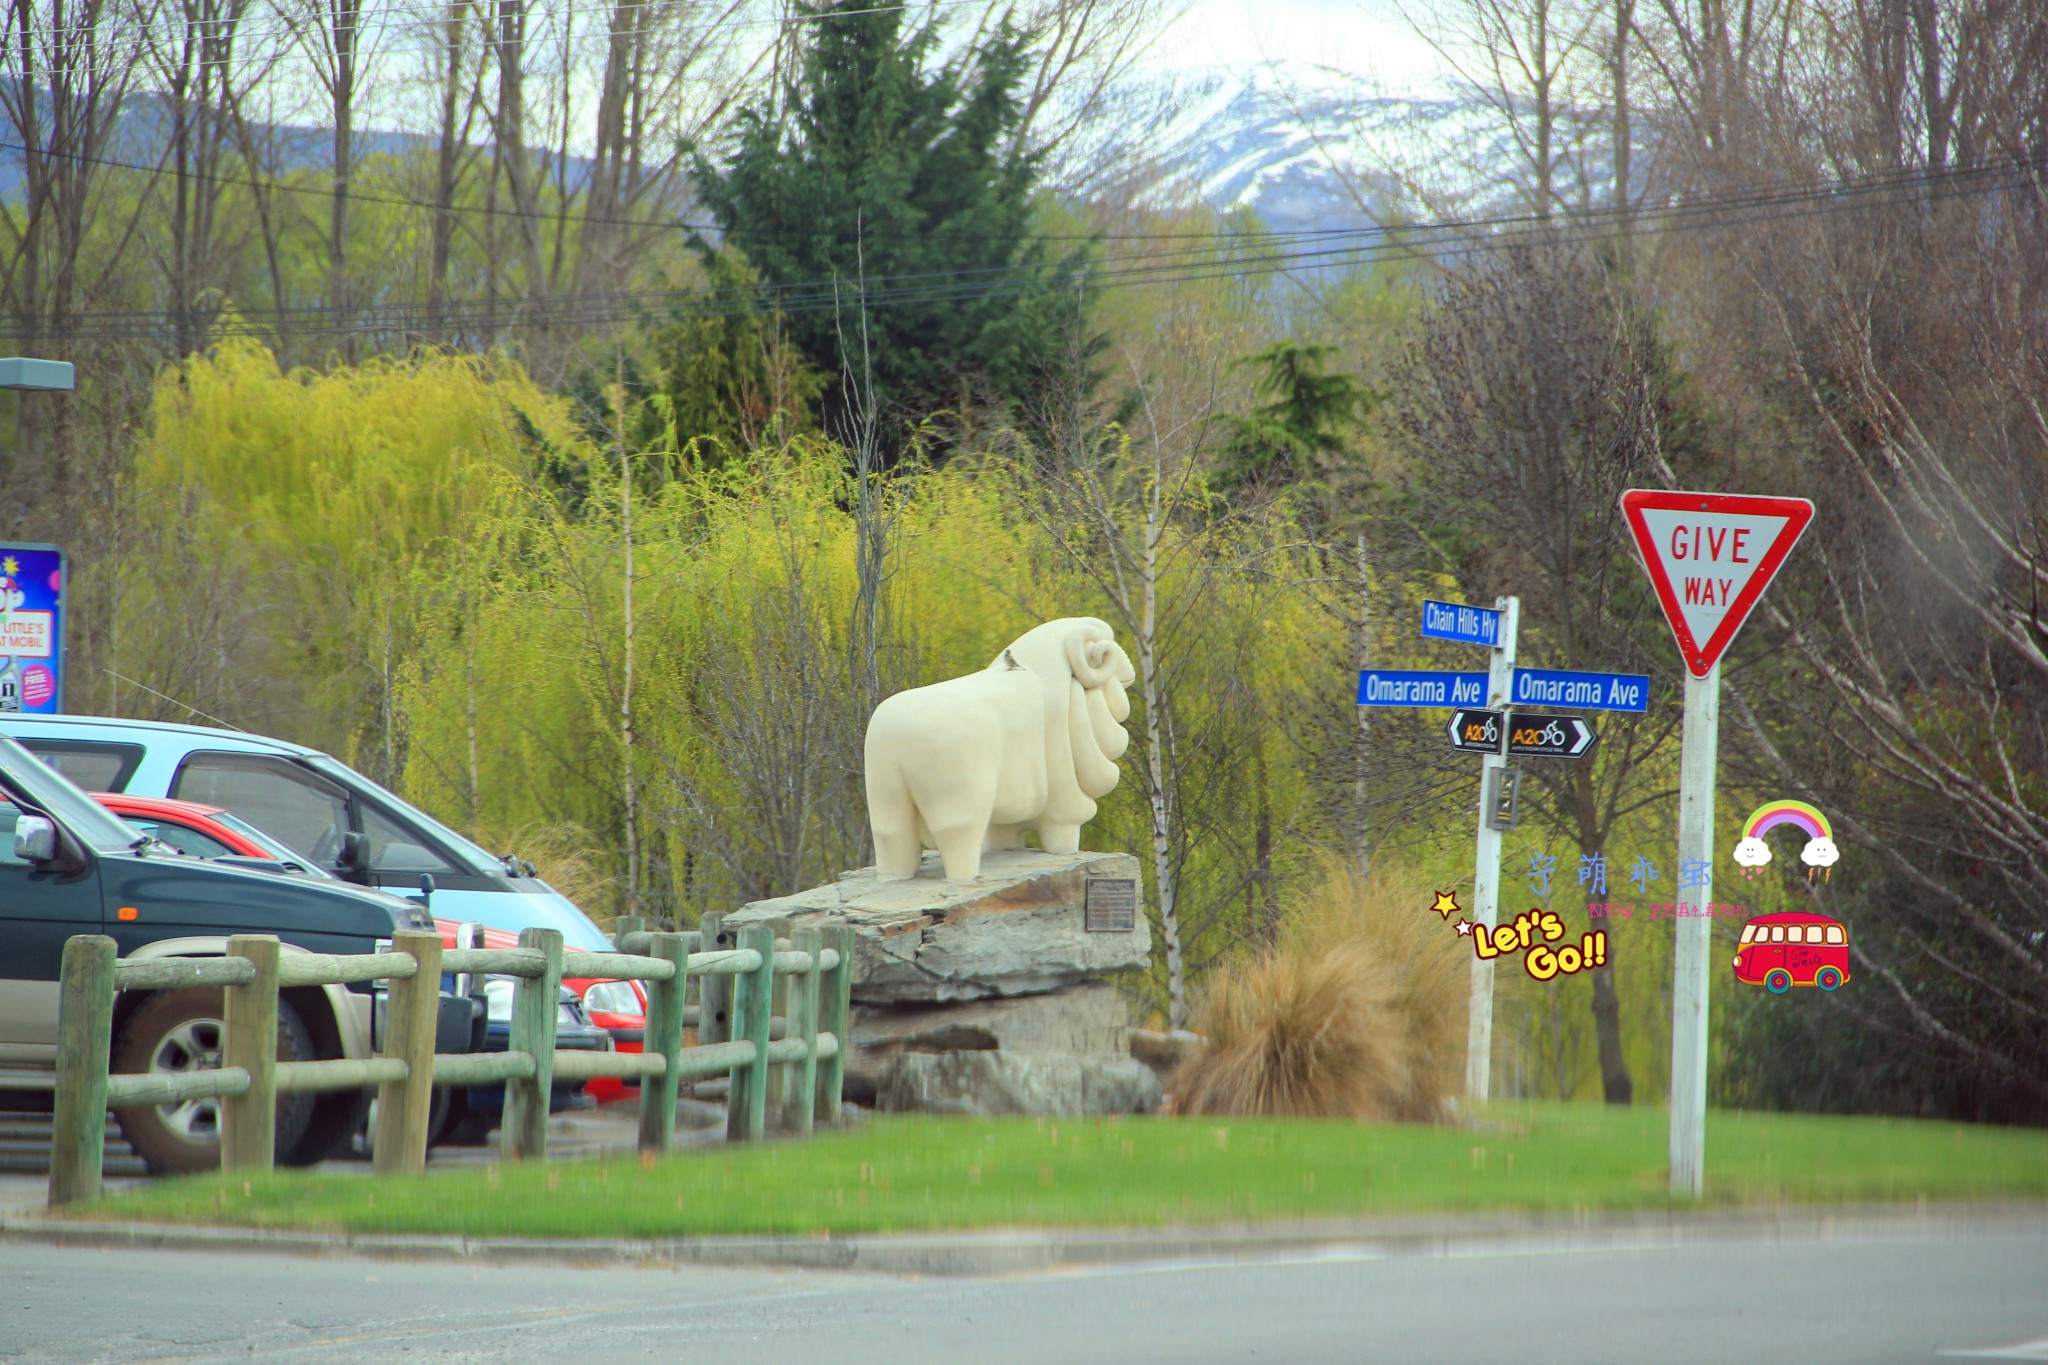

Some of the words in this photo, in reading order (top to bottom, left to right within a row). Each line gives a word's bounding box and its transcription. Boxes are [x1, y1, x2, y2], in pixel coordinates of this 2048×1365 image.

[1671, 525, 1750, 563] GIVE
[1685, 577, 1733, 607] WAY
[3, 622, 45, 635] LITTLE'S
[1426, 602, 1454, 632] Chain
[1457, 607, 1479, 636] Hills
[1482, 611, 1496, 643] Hy
[10, 637, 43, 648] MOBIL
[1367, 674, 1445, 702] Omarama
[1451, 677, 1481, 703] Ave
[1519, 673, 1601, 704] Omarama
[1607, 679, 1639, 706] Ave
